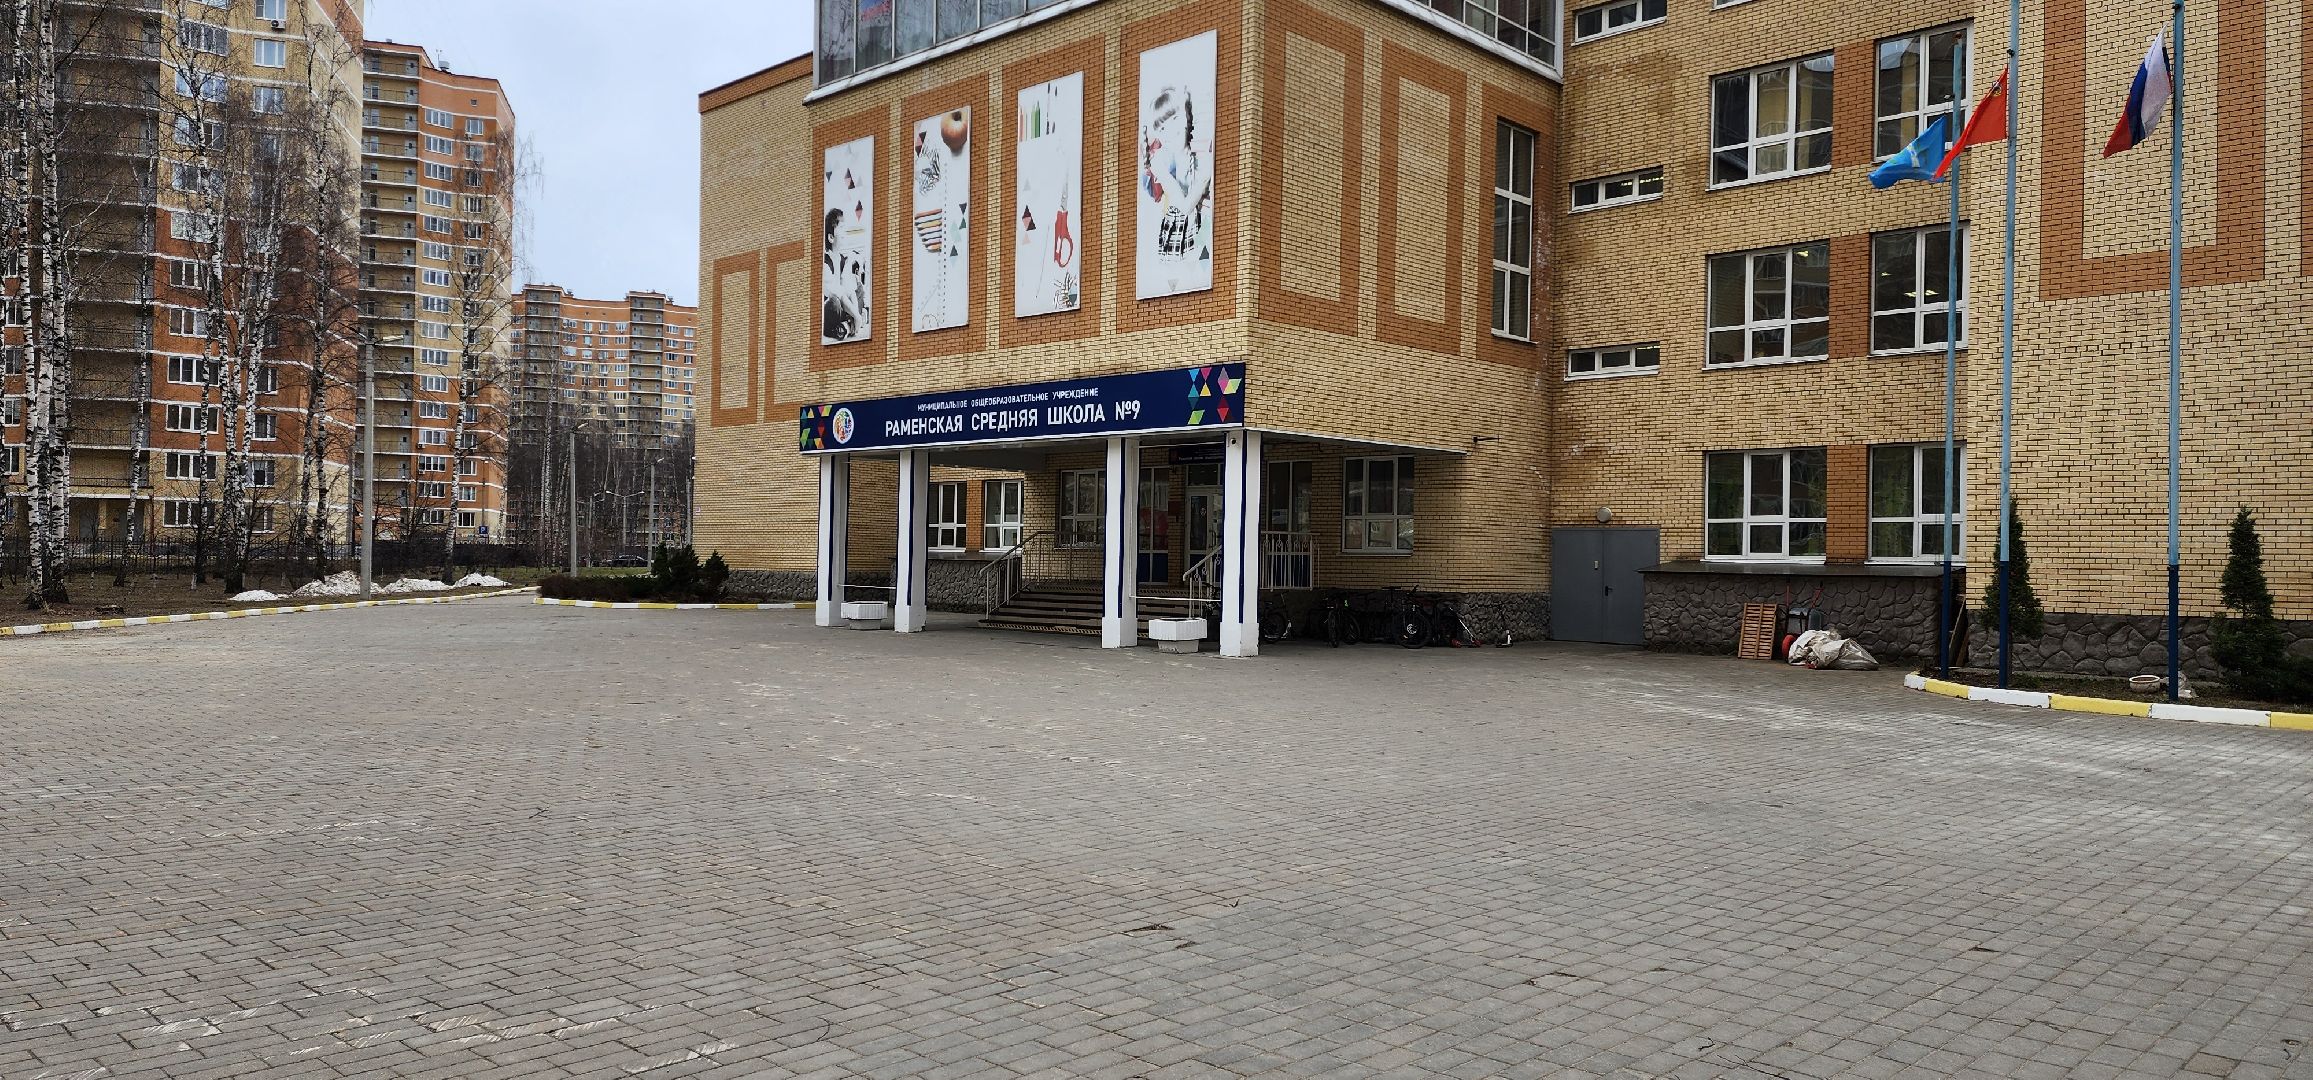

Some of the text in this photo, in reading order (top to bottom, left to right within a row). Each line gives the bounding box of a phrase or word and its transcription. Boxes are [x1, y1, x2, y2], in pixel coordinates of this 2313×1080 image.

[971, 392, 1049, 408] ОБЩЕОБРАЗОВАТЕЛЬНОЕ
[1052, 387, 1099, 400] УЧРЕЖДЕНИЕ
[885, 399, 1141, 438] РАМЕНСКАЯ СРЕДНЯЯ ШКОЛА №9
